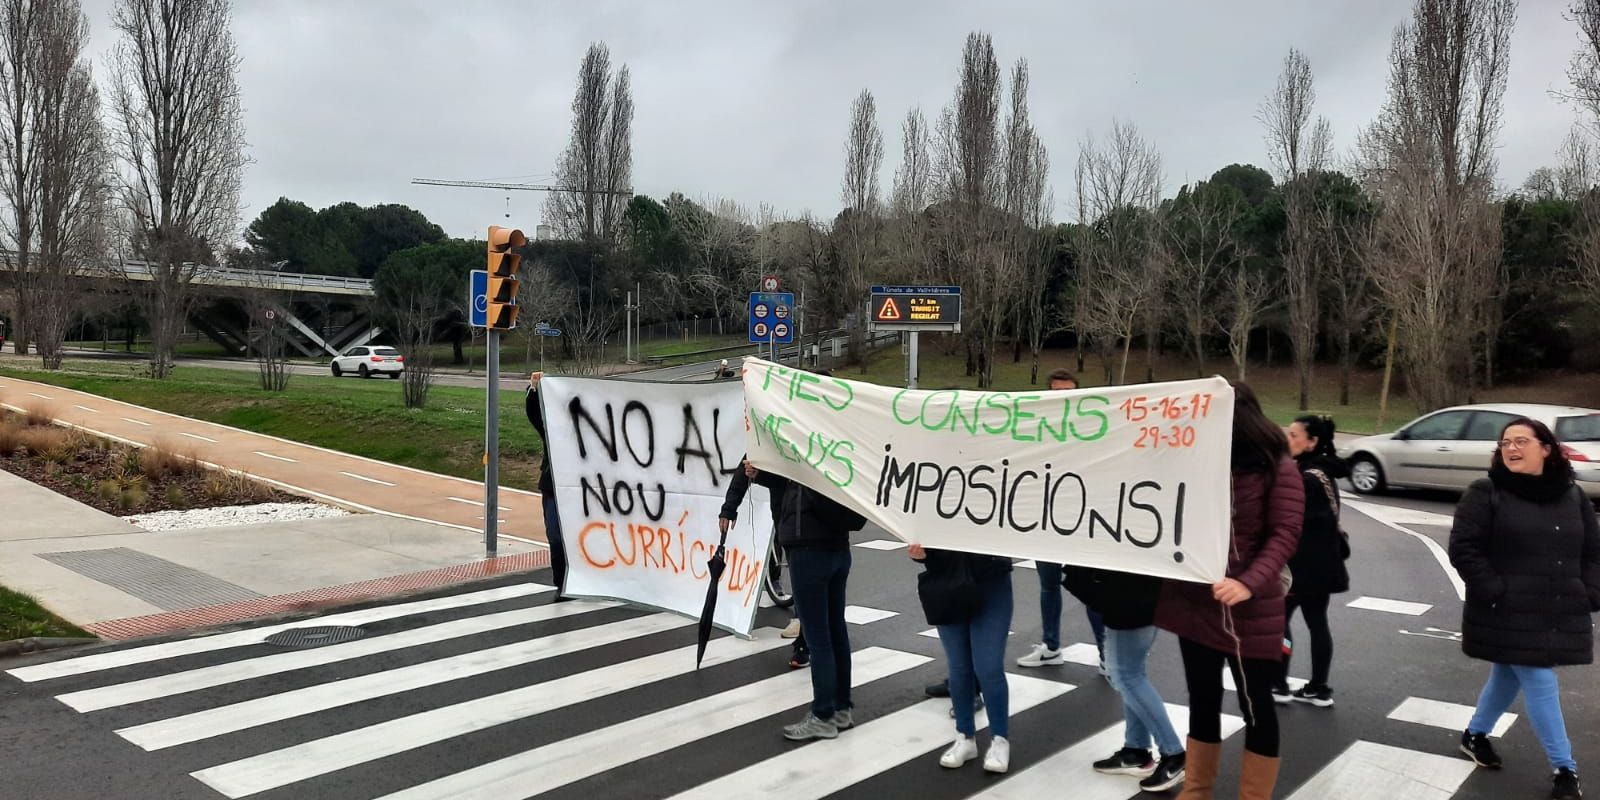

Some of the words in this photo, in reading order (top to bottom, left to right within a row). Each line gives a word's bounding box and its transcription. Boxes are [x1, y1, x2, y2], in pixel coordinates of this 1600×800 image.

[893, 389, 1110, 443] CONSENS
[1119, 393, 1212, 422] 15-16-17
[568, 396, 655, 469] NO
[675, 403, 739, 487] AL
[1133, 425, 1196, 448] 29-30
[580, 473, 666, 521] NOU
